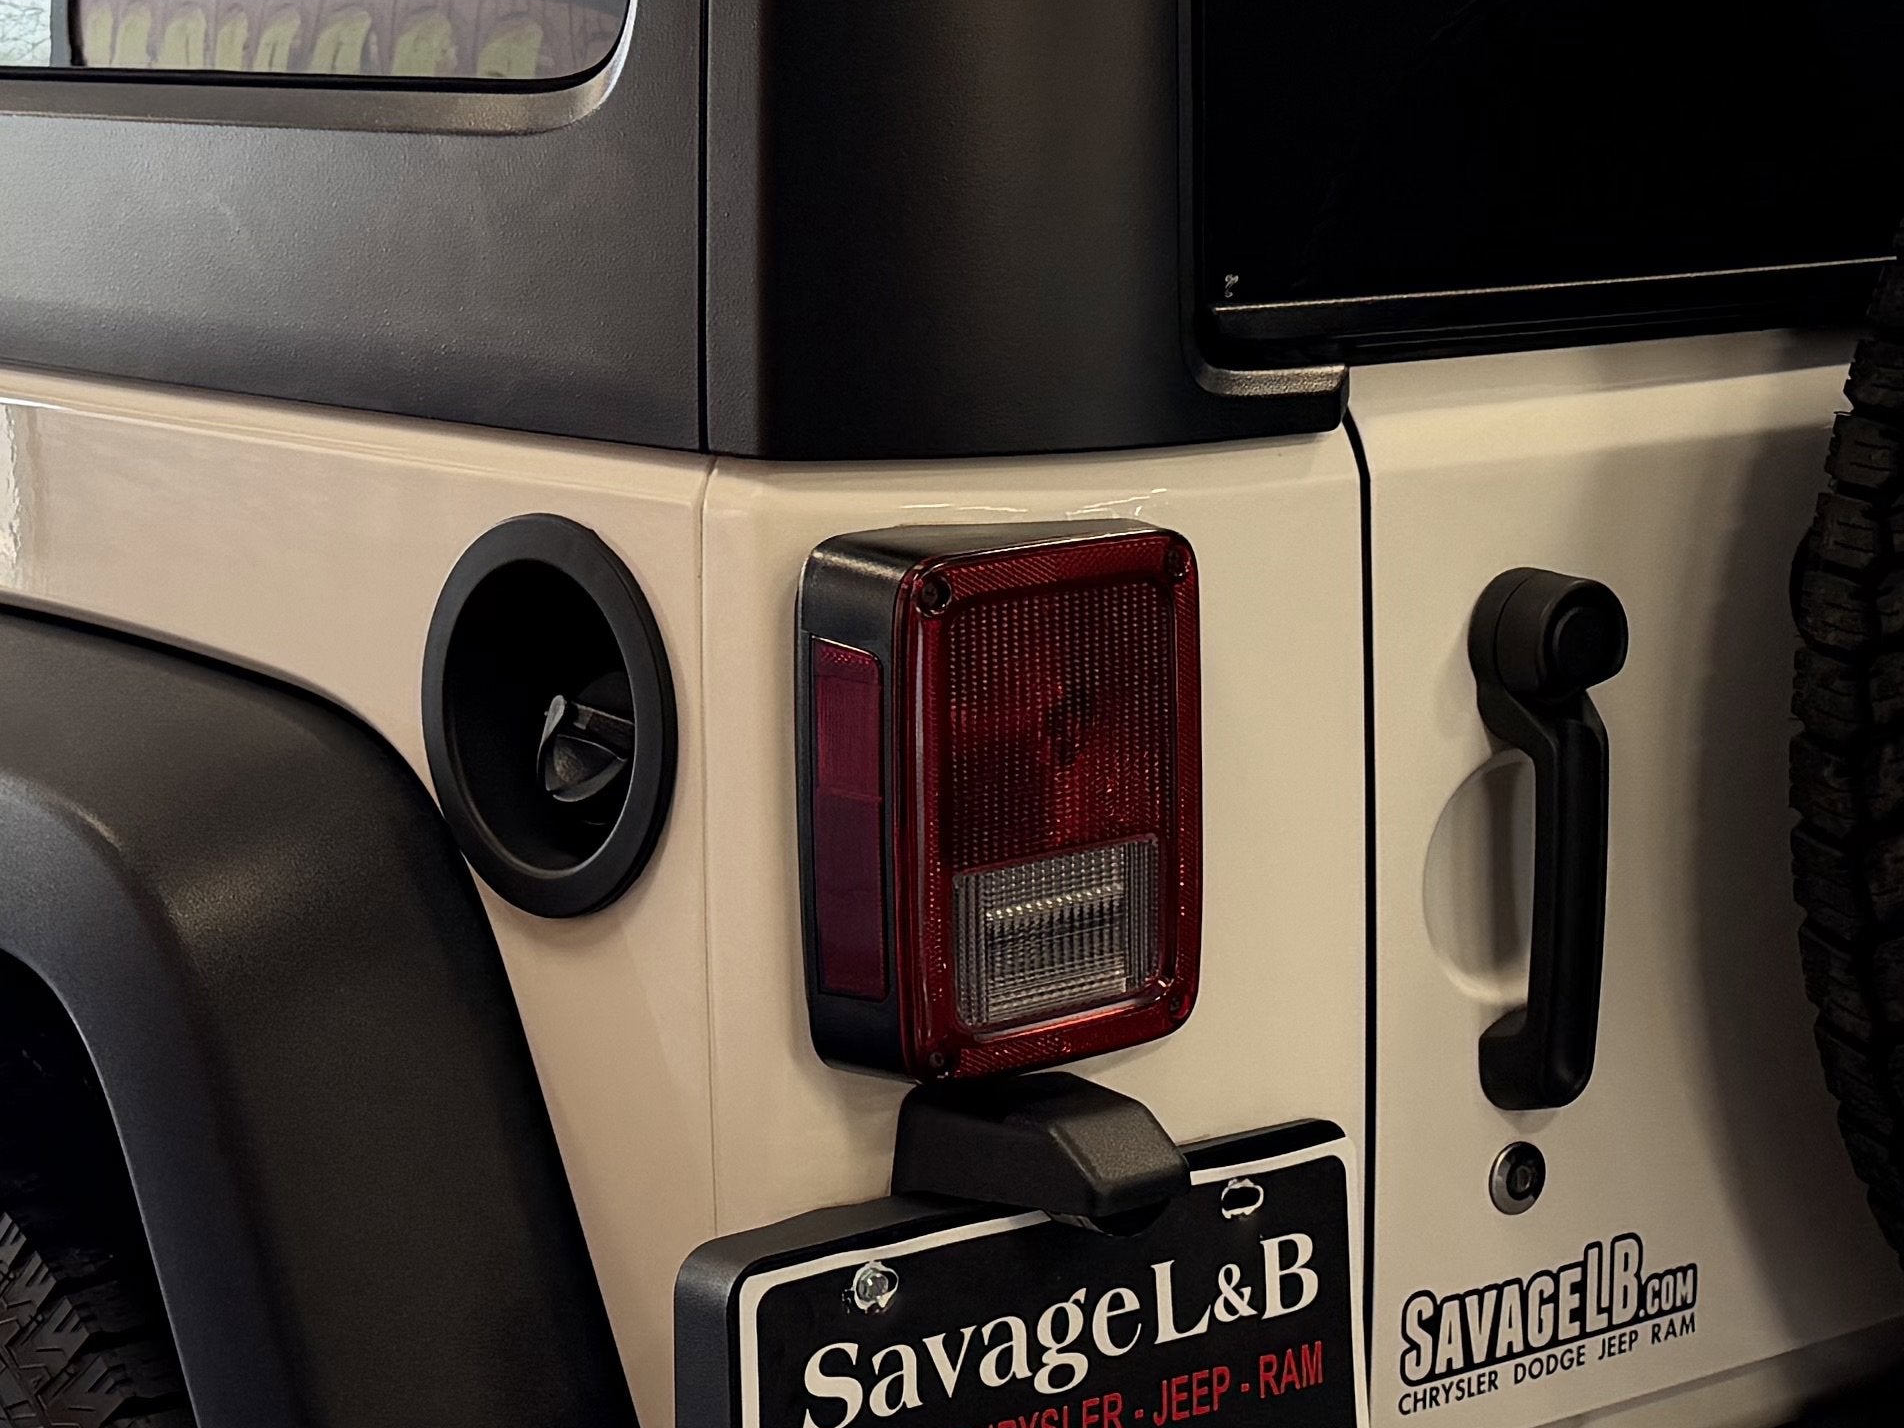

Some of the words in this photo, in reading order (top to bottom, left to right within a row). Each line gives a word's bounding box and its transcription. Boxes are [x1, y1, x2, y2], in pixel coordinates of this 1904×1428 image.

[1153, 1366, 1232, 1426] JEEP
[1259, 1341, 1324, 1399] RAM
[1398, 1371, 1498, 1415] CHRYSLER
[1514, 1345, 1586, 1385] DODGE
[1598, 1330, 1639, 1360] JEEP
[1651, 1312, 1696, 1345] RAM
